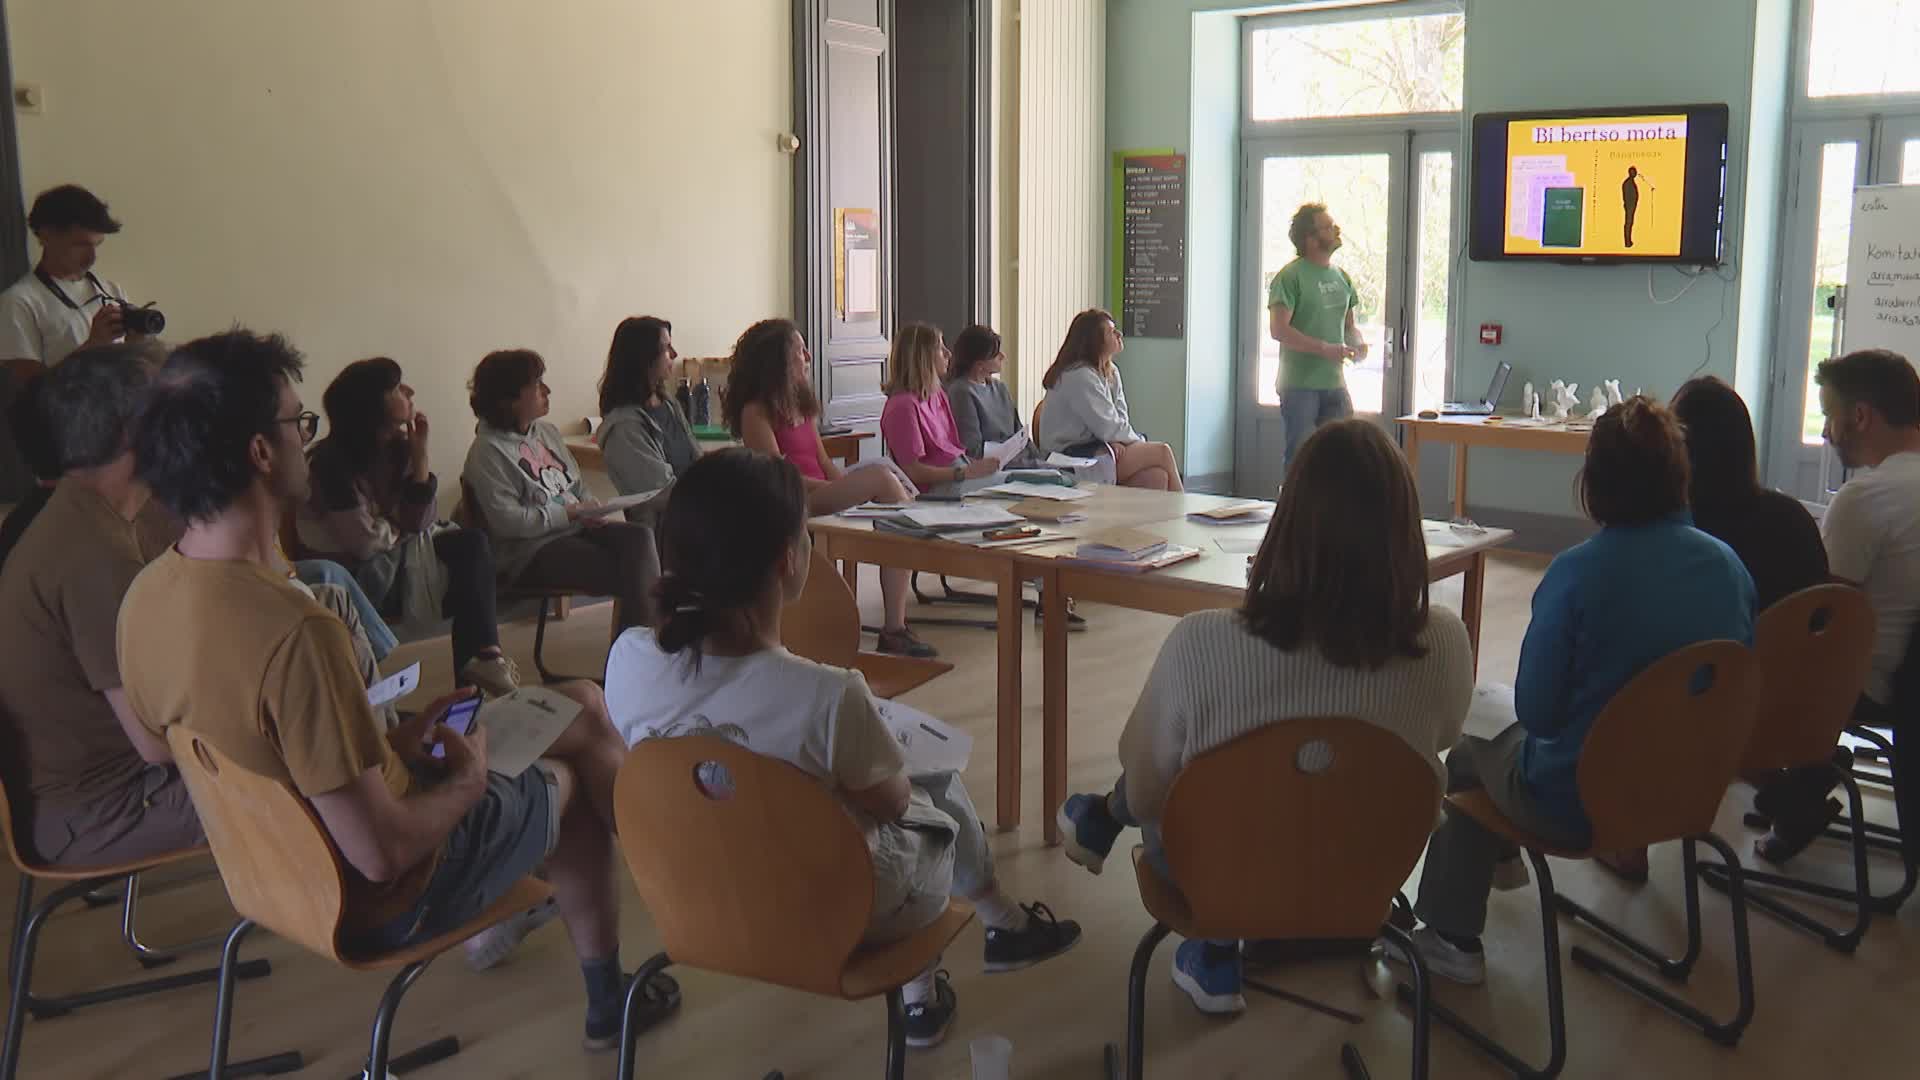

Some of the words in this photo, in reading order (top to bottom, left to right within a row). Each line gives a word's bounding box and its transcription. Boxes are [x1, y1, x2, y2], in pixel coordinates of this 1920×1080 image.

[1535, 127, 1553, 144] Bi
[1560, 125, 1620, 143] bertso
[1627, 125, 1677, 141] mota
